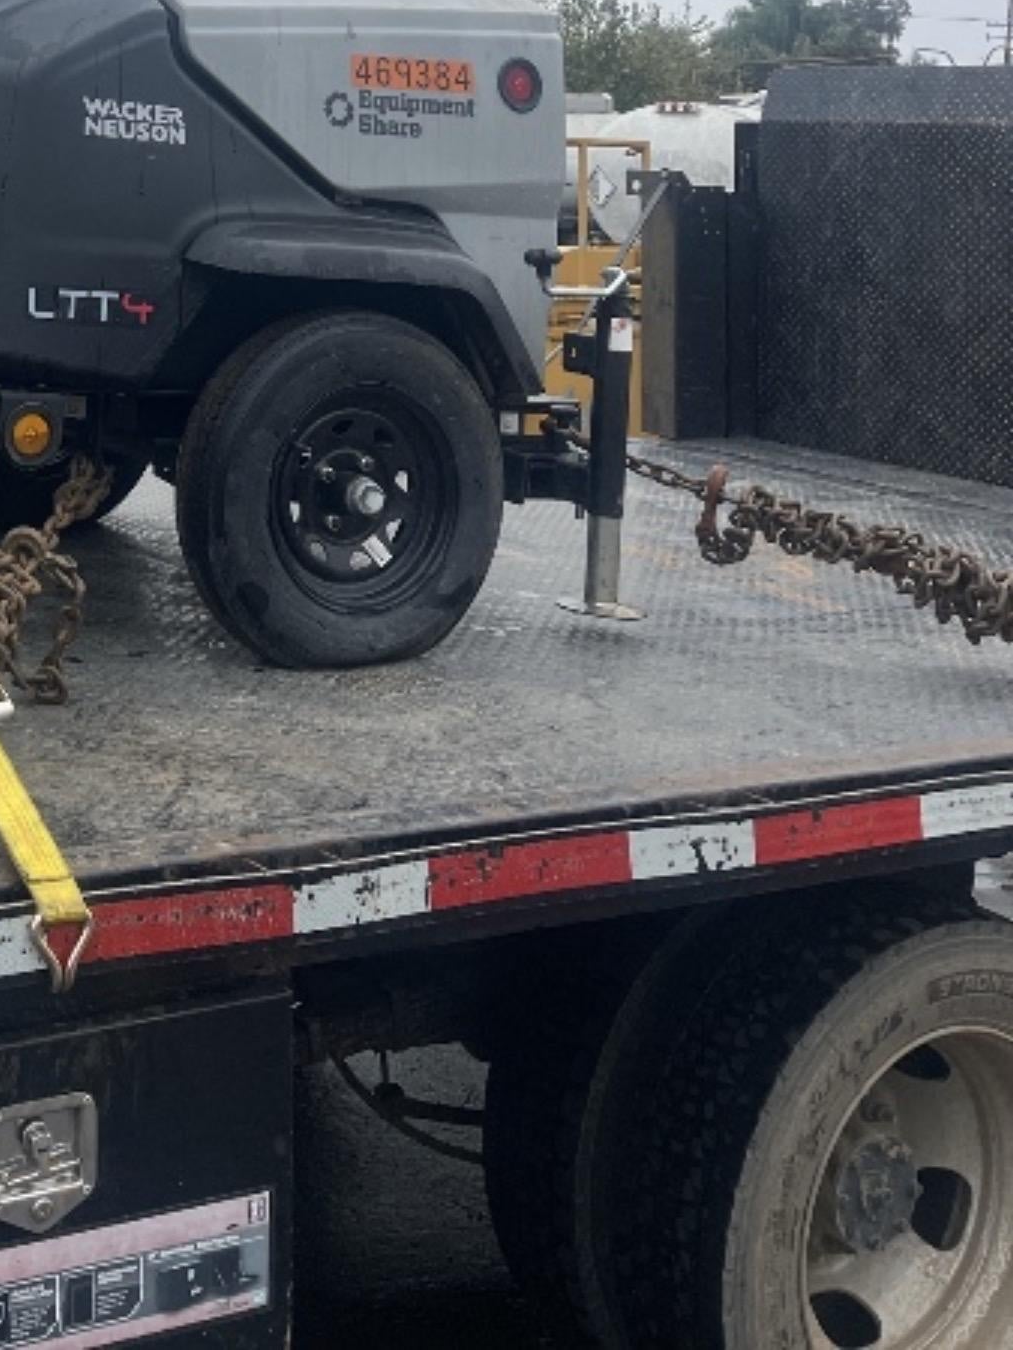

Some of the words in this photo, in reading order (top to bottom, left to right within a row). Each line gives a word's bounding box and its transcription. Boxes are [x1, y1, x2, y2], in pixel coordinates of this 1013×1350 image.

[355, 56, 471, 92] 469384
[82, 96, 186, 128] WACKER
[358, 89, 475, 118] Equipment
[85, 116, 186, 145] NEUSON
[358, 113, 422, 138] Share
[28, 287, 155, 325] LTT4
